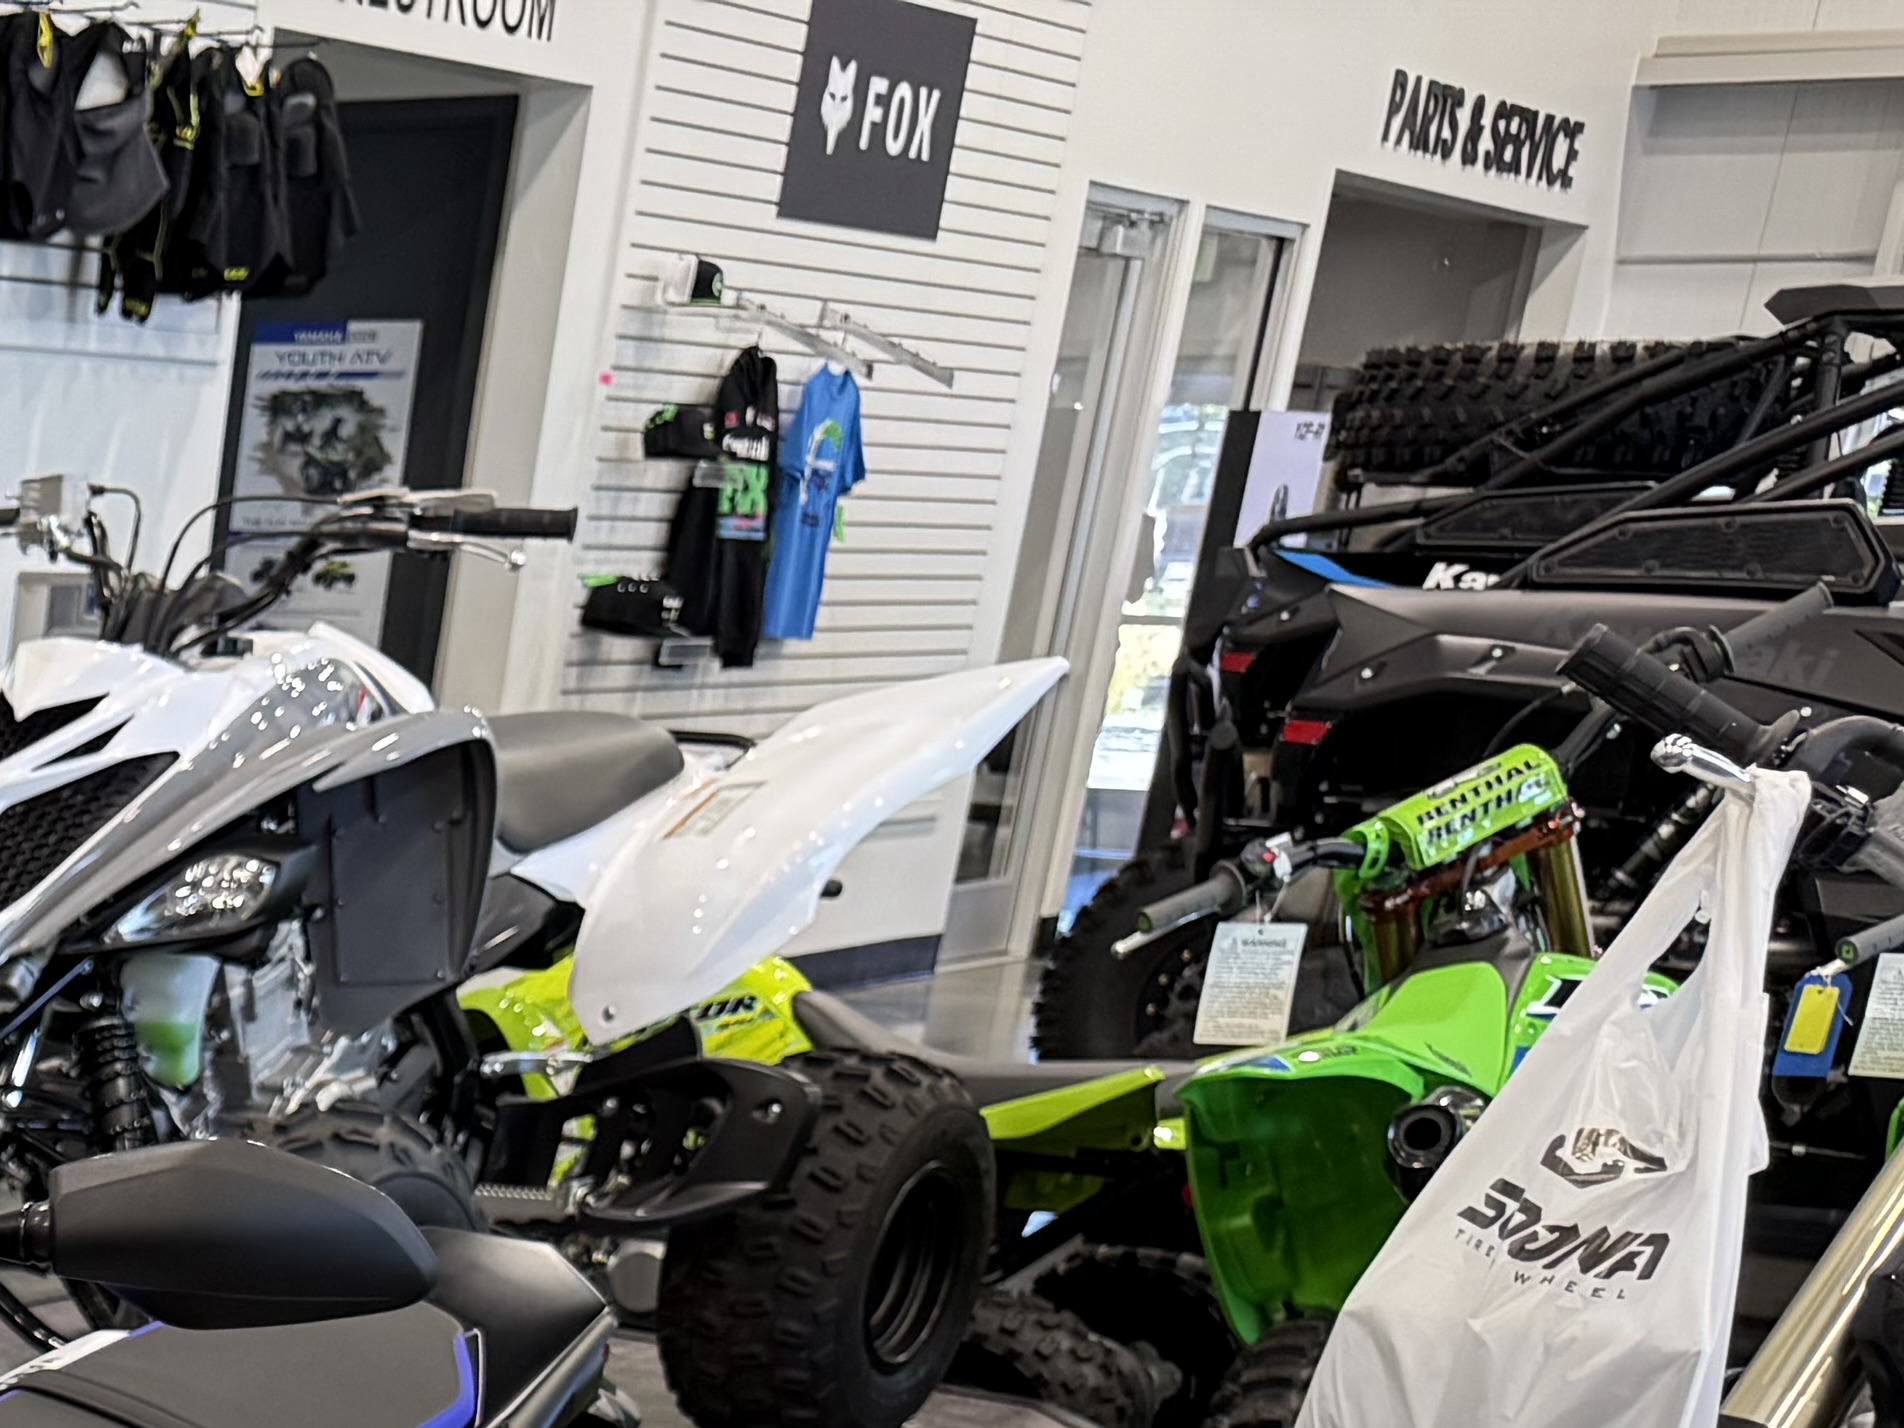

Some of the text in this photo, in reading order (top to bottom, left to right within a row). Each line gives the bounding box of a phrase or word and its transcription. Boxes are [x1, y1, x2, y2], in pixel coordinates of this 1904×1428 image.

[859, 75, 941, 161] FOX
[1382, 68, 1585, 189] PARTS & SERVICE
[1513, 1270, 1626, 1300] WHEEL
